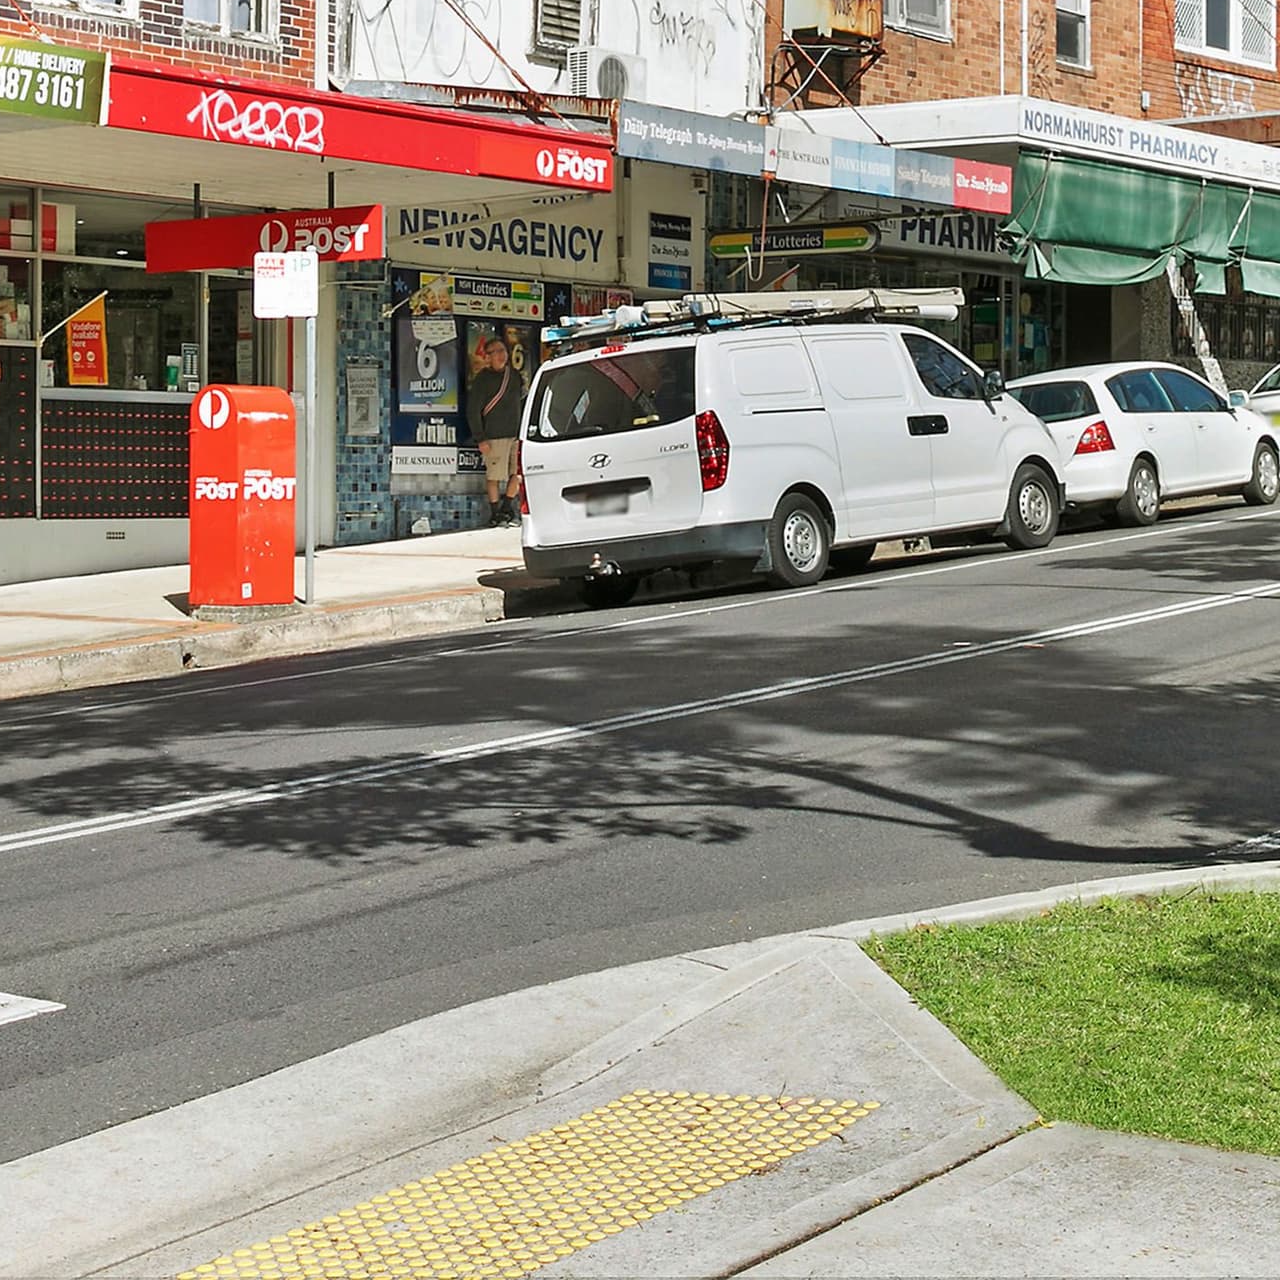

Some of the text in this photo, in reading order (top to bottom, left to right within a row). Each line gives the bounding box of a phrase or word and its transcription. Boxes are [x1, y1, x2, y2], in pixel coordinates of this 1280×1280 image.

[14, 49, 42, 68] HOME
[42, 52, 86, 76] DELIVERY
[35, 72, 85, 110] 3161
[624, 118, 693, 147] Daily Telegraph
[1023, 109, 1124, 149] NORMANHURST
[1130, 131, 1219, 166] PHARMACY
[557, 154, 608, 183] POST
[790, 151, 830, 166] AUSTRALIAN
[295, 217, 333, 228] AUSTRALIA
[294, 223, 369, 254] POST
[400, 208, 603, 263] NEWSAGENCY
[772, 232, 821, 249] Lotteries
[472, 281, 508, 297] Lotteries
[416, 340, 438, 379] 6
[512, 343, 524, 369] 6
[410, 379, 445, 392] MILLION
[395, 456, 451, 465] THE AUSTRALIAN
[459, 453, 480, 469] Daily
[195, 482, 240, 500] POST
[244, 477, 297, 500] POST
